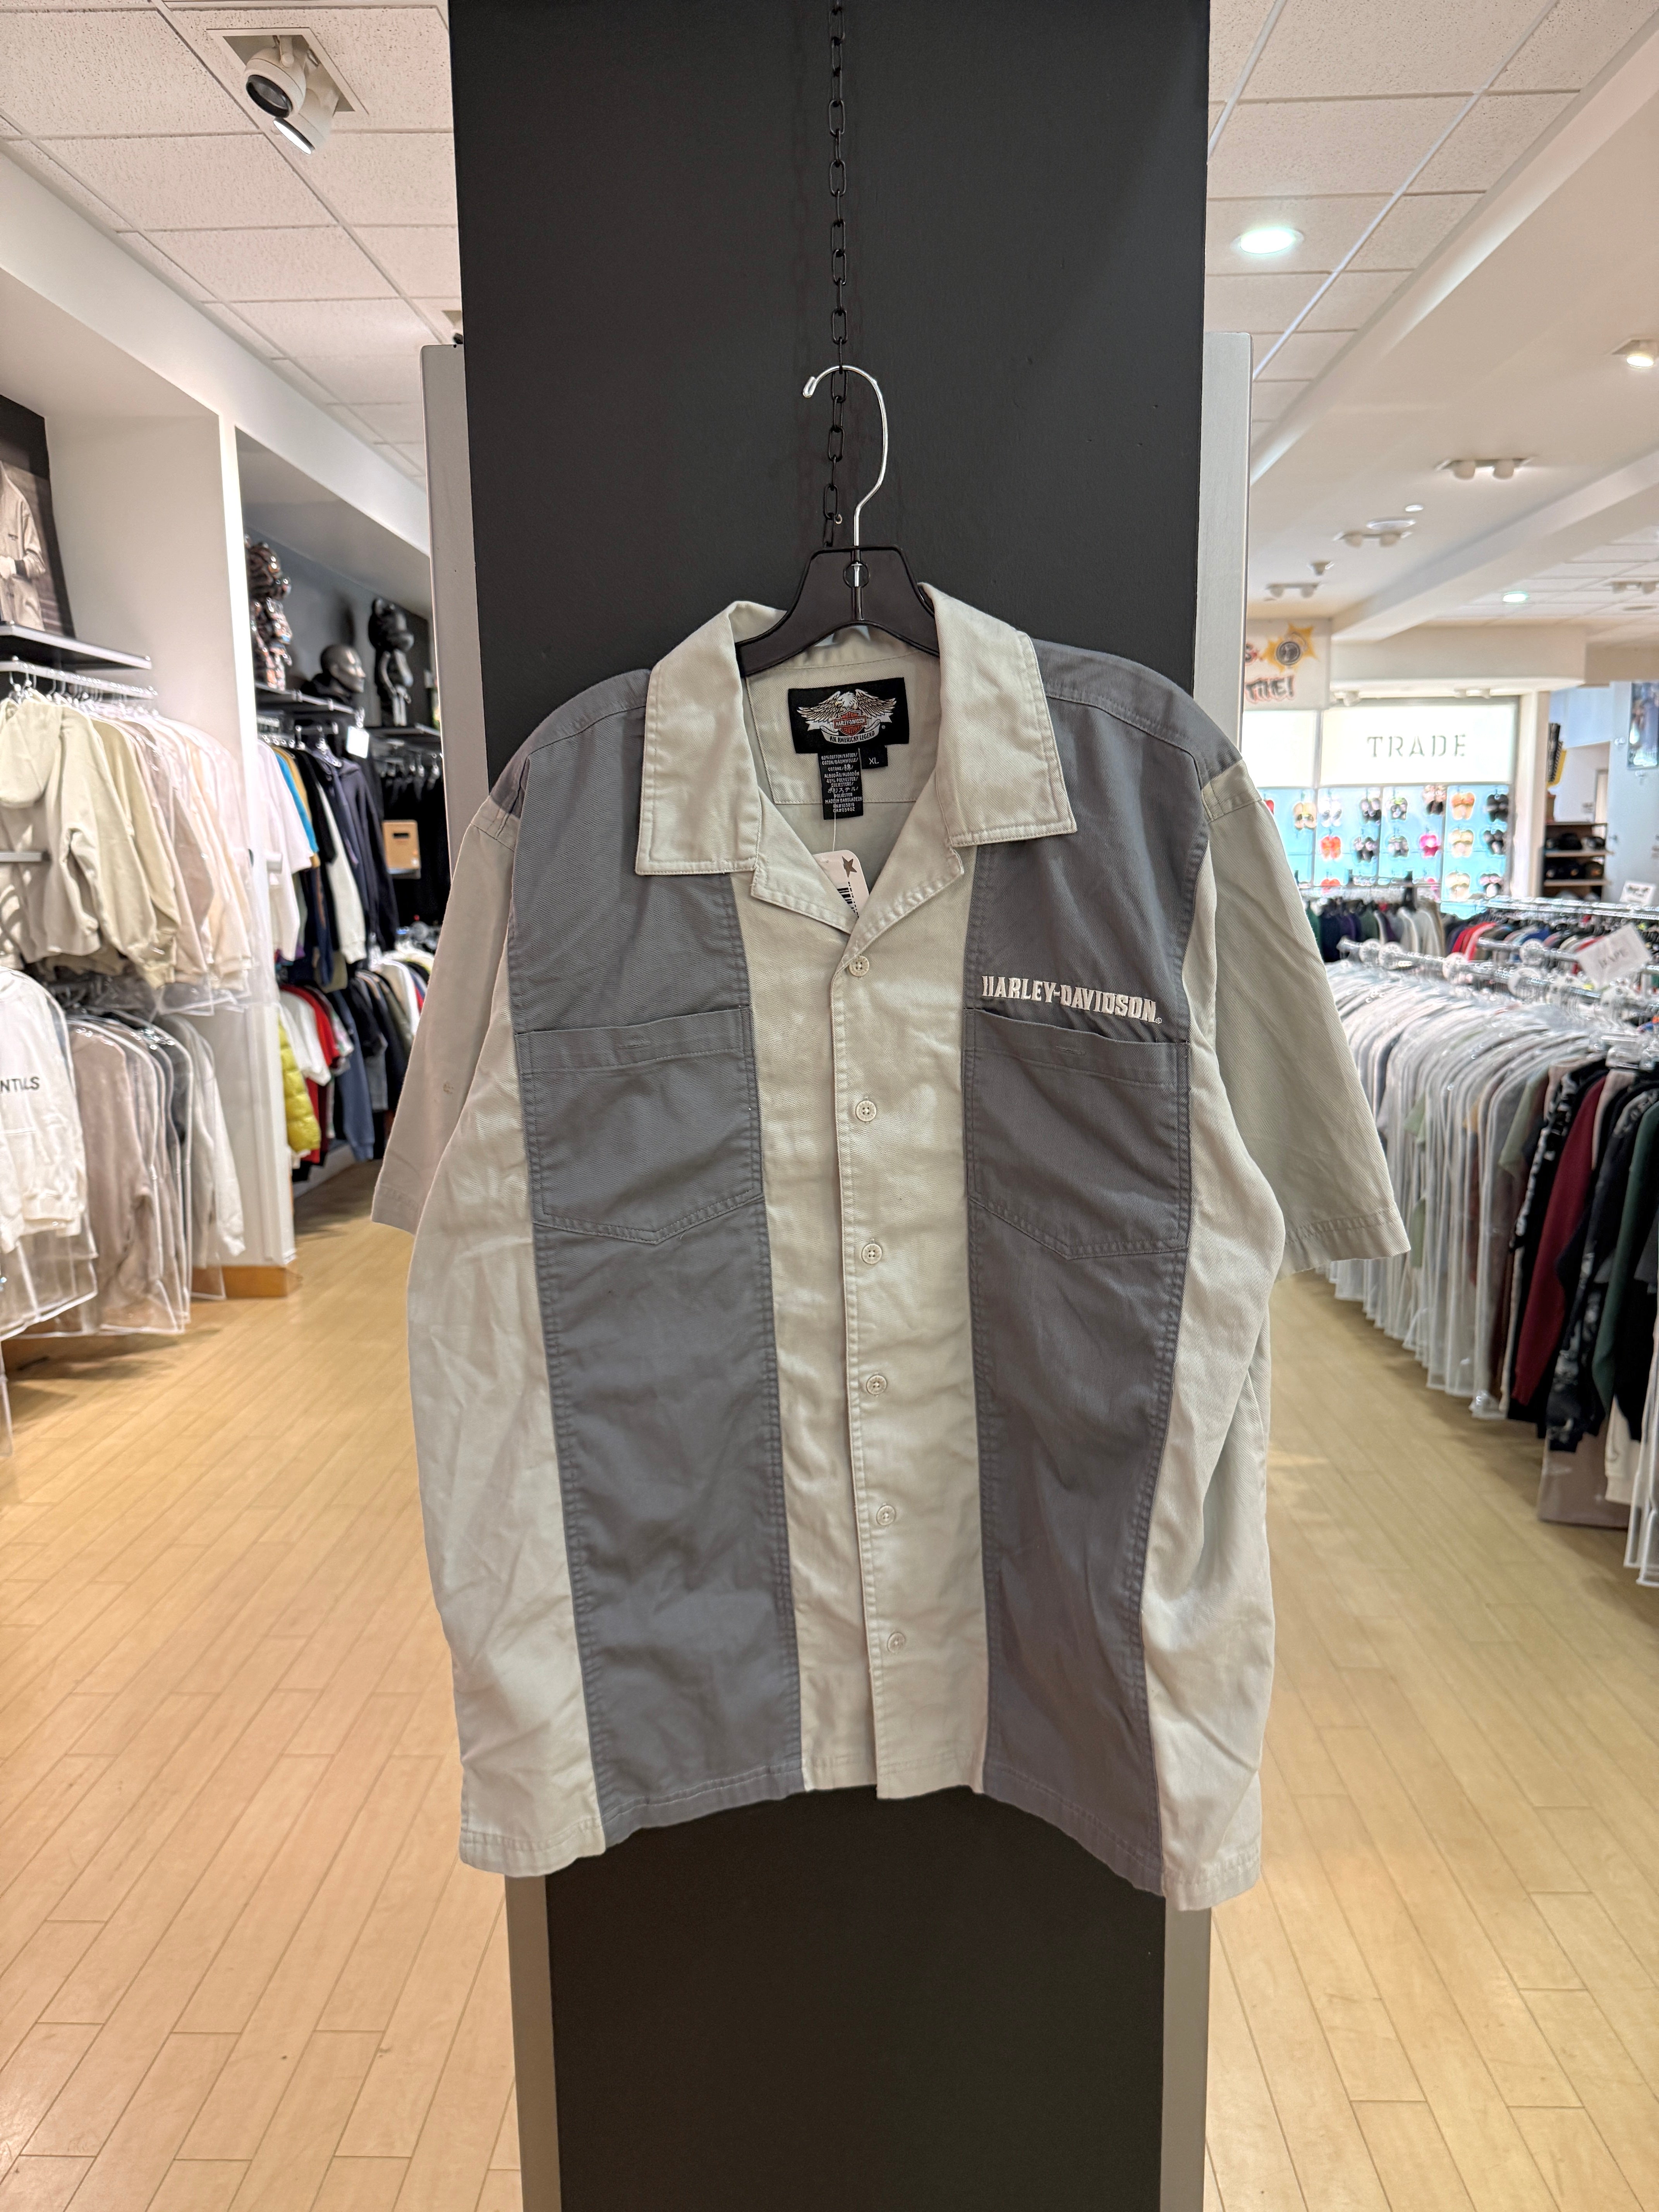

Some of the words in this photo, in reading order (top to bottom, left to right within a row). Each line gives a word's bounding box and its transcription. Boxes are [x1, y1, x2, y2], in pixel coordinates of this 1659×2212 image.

[859, 731, 874, 740] LEGEND
[1367, 734, 1465, 757] TRADE
[982, 975, 1156, 1022] HARLEY-DAVIDSON
